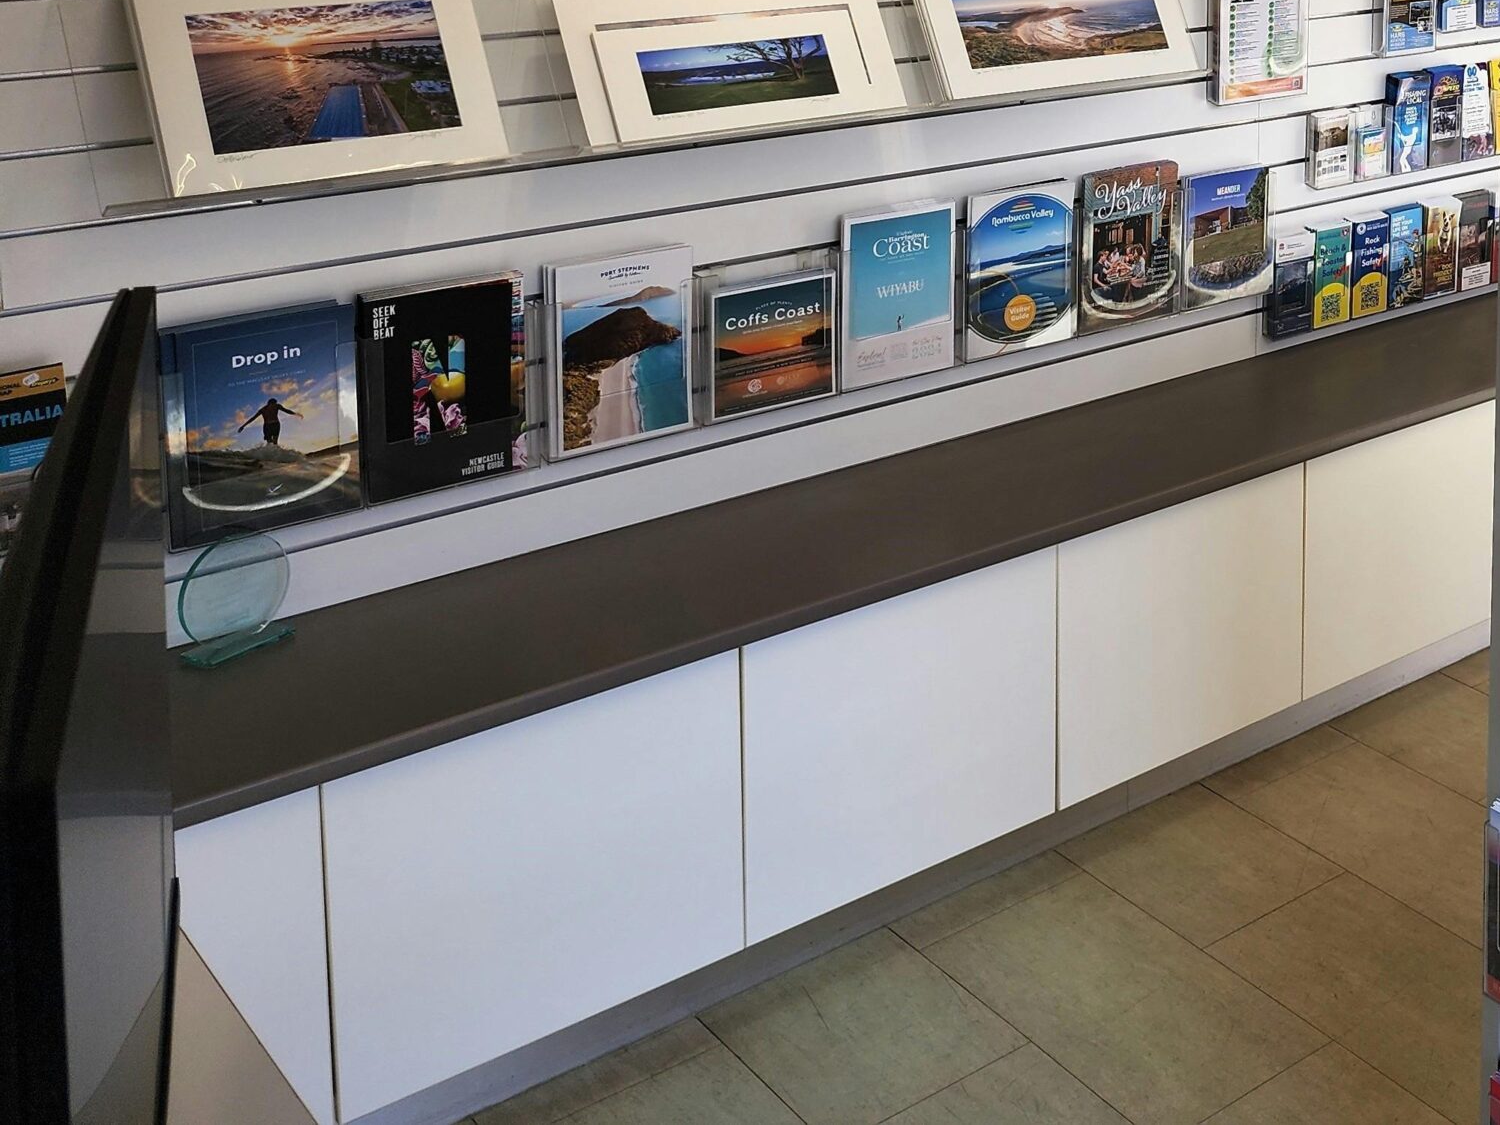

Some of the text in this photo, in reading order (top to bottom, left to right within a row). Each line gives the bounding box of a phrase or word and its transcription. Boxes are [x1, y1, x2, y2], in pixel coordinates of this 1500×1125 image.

[1216, 183, 1241, 196] MEANDER
[1096, 177, 1142, 220] Yass
[1116, 186, 1167, 216] Valley
[991, 208, 1054, 227] Nambucca Valley
[872, 233, 930, 258] Coast
[1365, 235, 1380, 245] Rock
[1320, 246, 1339, 256] Beach
[1361, 244, 1384, 257] Fishing
[1361, 257, 1381, 268] Safety
[600, 269, 617, 278] PORT
[617, 264, 650, 274] STEPHENS
[372, 304, 396, 319] SEEK
[725, 312, 769, 331] Coffs
[774, 302, 820, 321] Coast
[373, 318, 390, 329] OFF
[373, 327, 395, 340] BEAT
[231, 345, 301, 369] Drop in
[468, 452, 505, 467] NEWCASTLE
[460, 461, 486, 476] VISITOR
